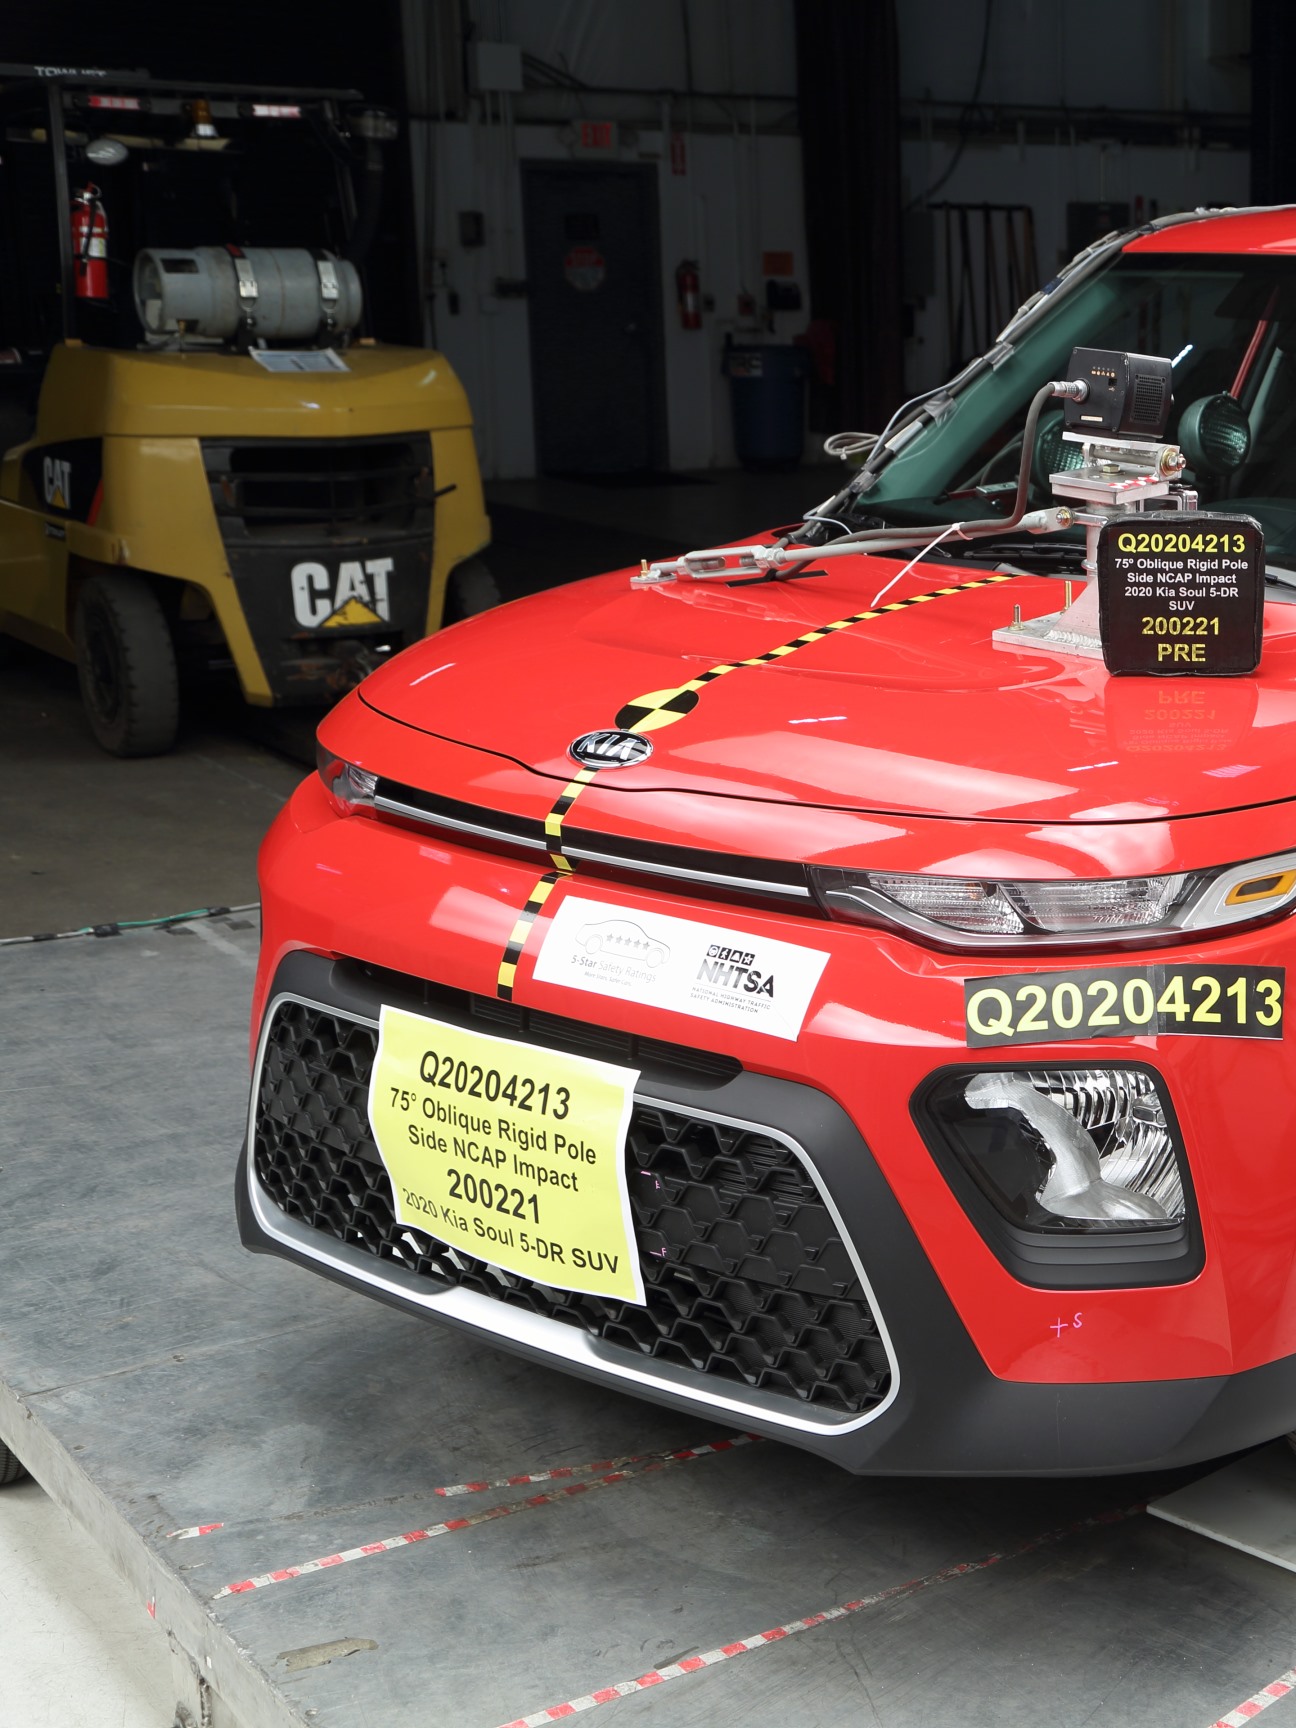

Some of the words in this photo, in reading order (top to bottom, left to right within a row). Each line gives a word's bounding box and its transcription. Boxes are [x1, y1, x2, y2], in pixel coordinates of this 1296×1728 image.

[581, 122, 612, 148] EXIT
[43, 455, 72, 510] CAT
[1118, 533, 1245, 553] Q20204213
[1127, 573, 1153, 582] Side
[1157, 573, 1192, 583] NCAP
[1196, 574, 1236, 585] Impact
[1137, 559, 1183, 571] Oblique
[1187, 560, 1218, 571] Rigid
[1222, 560, 1248, 569] Pole
[290, 557, 394, 629] CAT
[1125, 587, 1152, 596] 2020
[1156, 587, 1175, 596] Kia
[1179, 587, 1205, 597] Soul
[1210, 588, 1238, 597] 5-DR
[1169, 601, 1195, 610] SUV
[1142, 617, 1219, 635] 200221
[1158, 644, 1206, 661] PRE
[577, 732, 640, 760] KIA
[571, 954, 598, 968] 5-Star
[598, 960, 624, 977] Safety
[625, 966, 657, 984] Ratings
[696, 958, 774, 998] NHTSA
[690, 993, 710, 1001] SAFETY
[711, 998, 758, 1013] ADMINISTRATION
[691, 986, 718, 997] NATIONAL
[720, 993, 746, 1003] HIGHWAY
[748, 1000, 771, 1010] TRAFFIC
[966, 976, 1282, 1037] Q20204213
[420, 1051, 570, 1120] Q20204213
[422, 1097, 491, 1135] Oblique
[498, 1119, 547, 1151] Rigid
[555, 1134, 596, 1165] Pole
[409, 1125, 447, 1153] Side
[453, 1137, 506, 1169] NCAP
[514, 1154, 578, 1192] Impact
[447, 1169, 540, 1224] 200221
[403, 1188, 437, 1218] 2020
[441, 1206, 469, 1232] Kia
[473, 1217, 514, 1247] Soul
[520, 1233, 565, 1265] 5-DR
[572, 1248, 618, 1274] SUV
